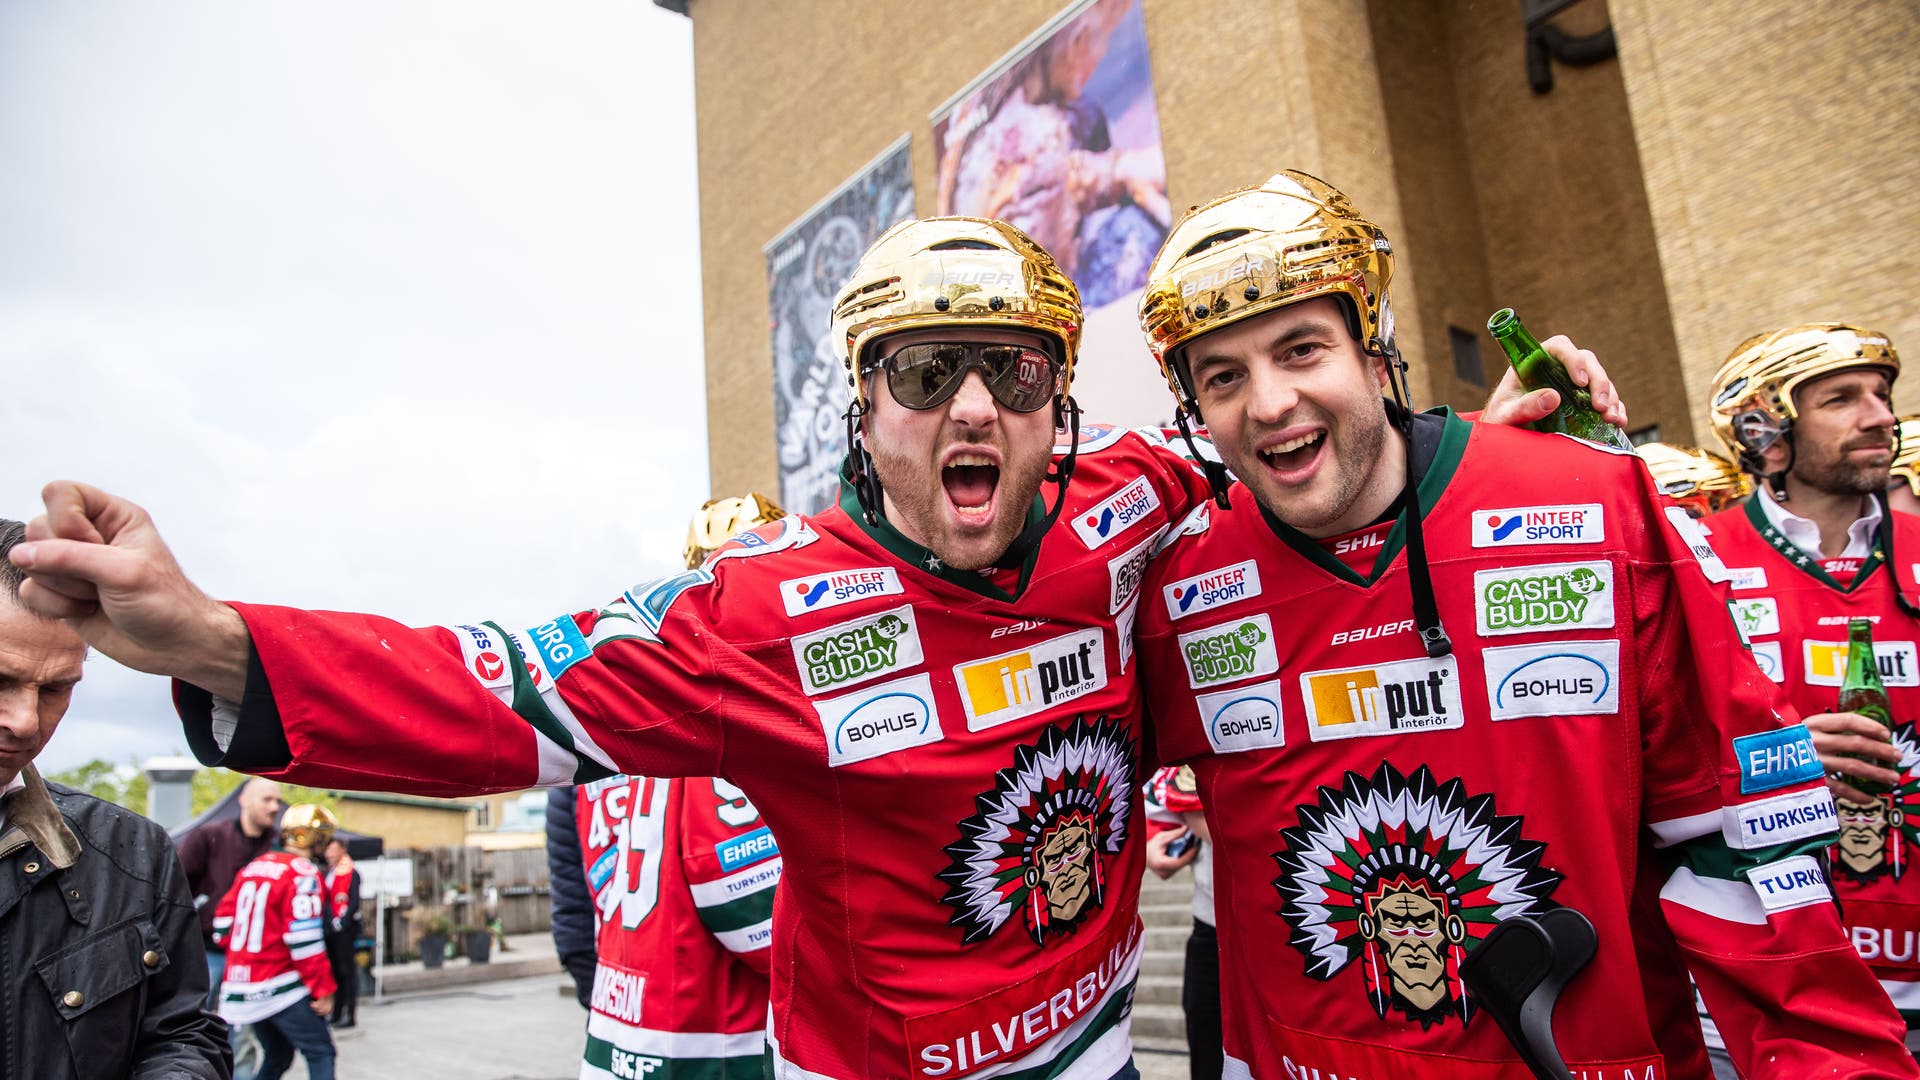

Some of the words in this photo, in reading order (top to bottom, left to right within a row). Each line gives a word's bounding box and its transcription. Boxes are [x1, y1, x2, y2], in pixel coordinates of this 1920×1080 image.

[1182, 258, 1264, 298] BAUER
[1111, 485, 1146, 513] INTER
[1119, 495, 1150, 524] SPORT
[1526, 511, 1584, 526] INTER
[1526, 525, 1584, 540] SPORT
[1335, 532, 1386, 555] SHL
[831, 571, 884, 588] INTER
[1824, 560, 1860, 573] SHL
[834, 581, 885, 600] SPORT
[1200, 569, 1244, 593] INTER
[1202, 582, 1246, 605] SPORT
[1488, 578, 1563, 604] CASH
[1489, 599, 1584, 627] BUDDY
[807, 627, 875, 665] CASH
[1331, 618, 1415, 646] BAUER
[1187, 634, 1237, 661] CASH
[810, 642, 897, 686] BUDDY
[1000, 642, 1095, 705] input
[1193, 650, 1256, 683] BUDDY
[1346, 669, 1447, 730] input
[1512, 678, 1593, 698] BOHUS
[846, 712, 918, 743] BOHUS
[1220, 715, 1273, 737] BOHUS
[1746, 804, 1827, 835] TURKISH
[723, 832, 778, 864] EHREN
[727, 868, 775, 893] TURKISH
[611, 1048, 663, 1080] SKF
